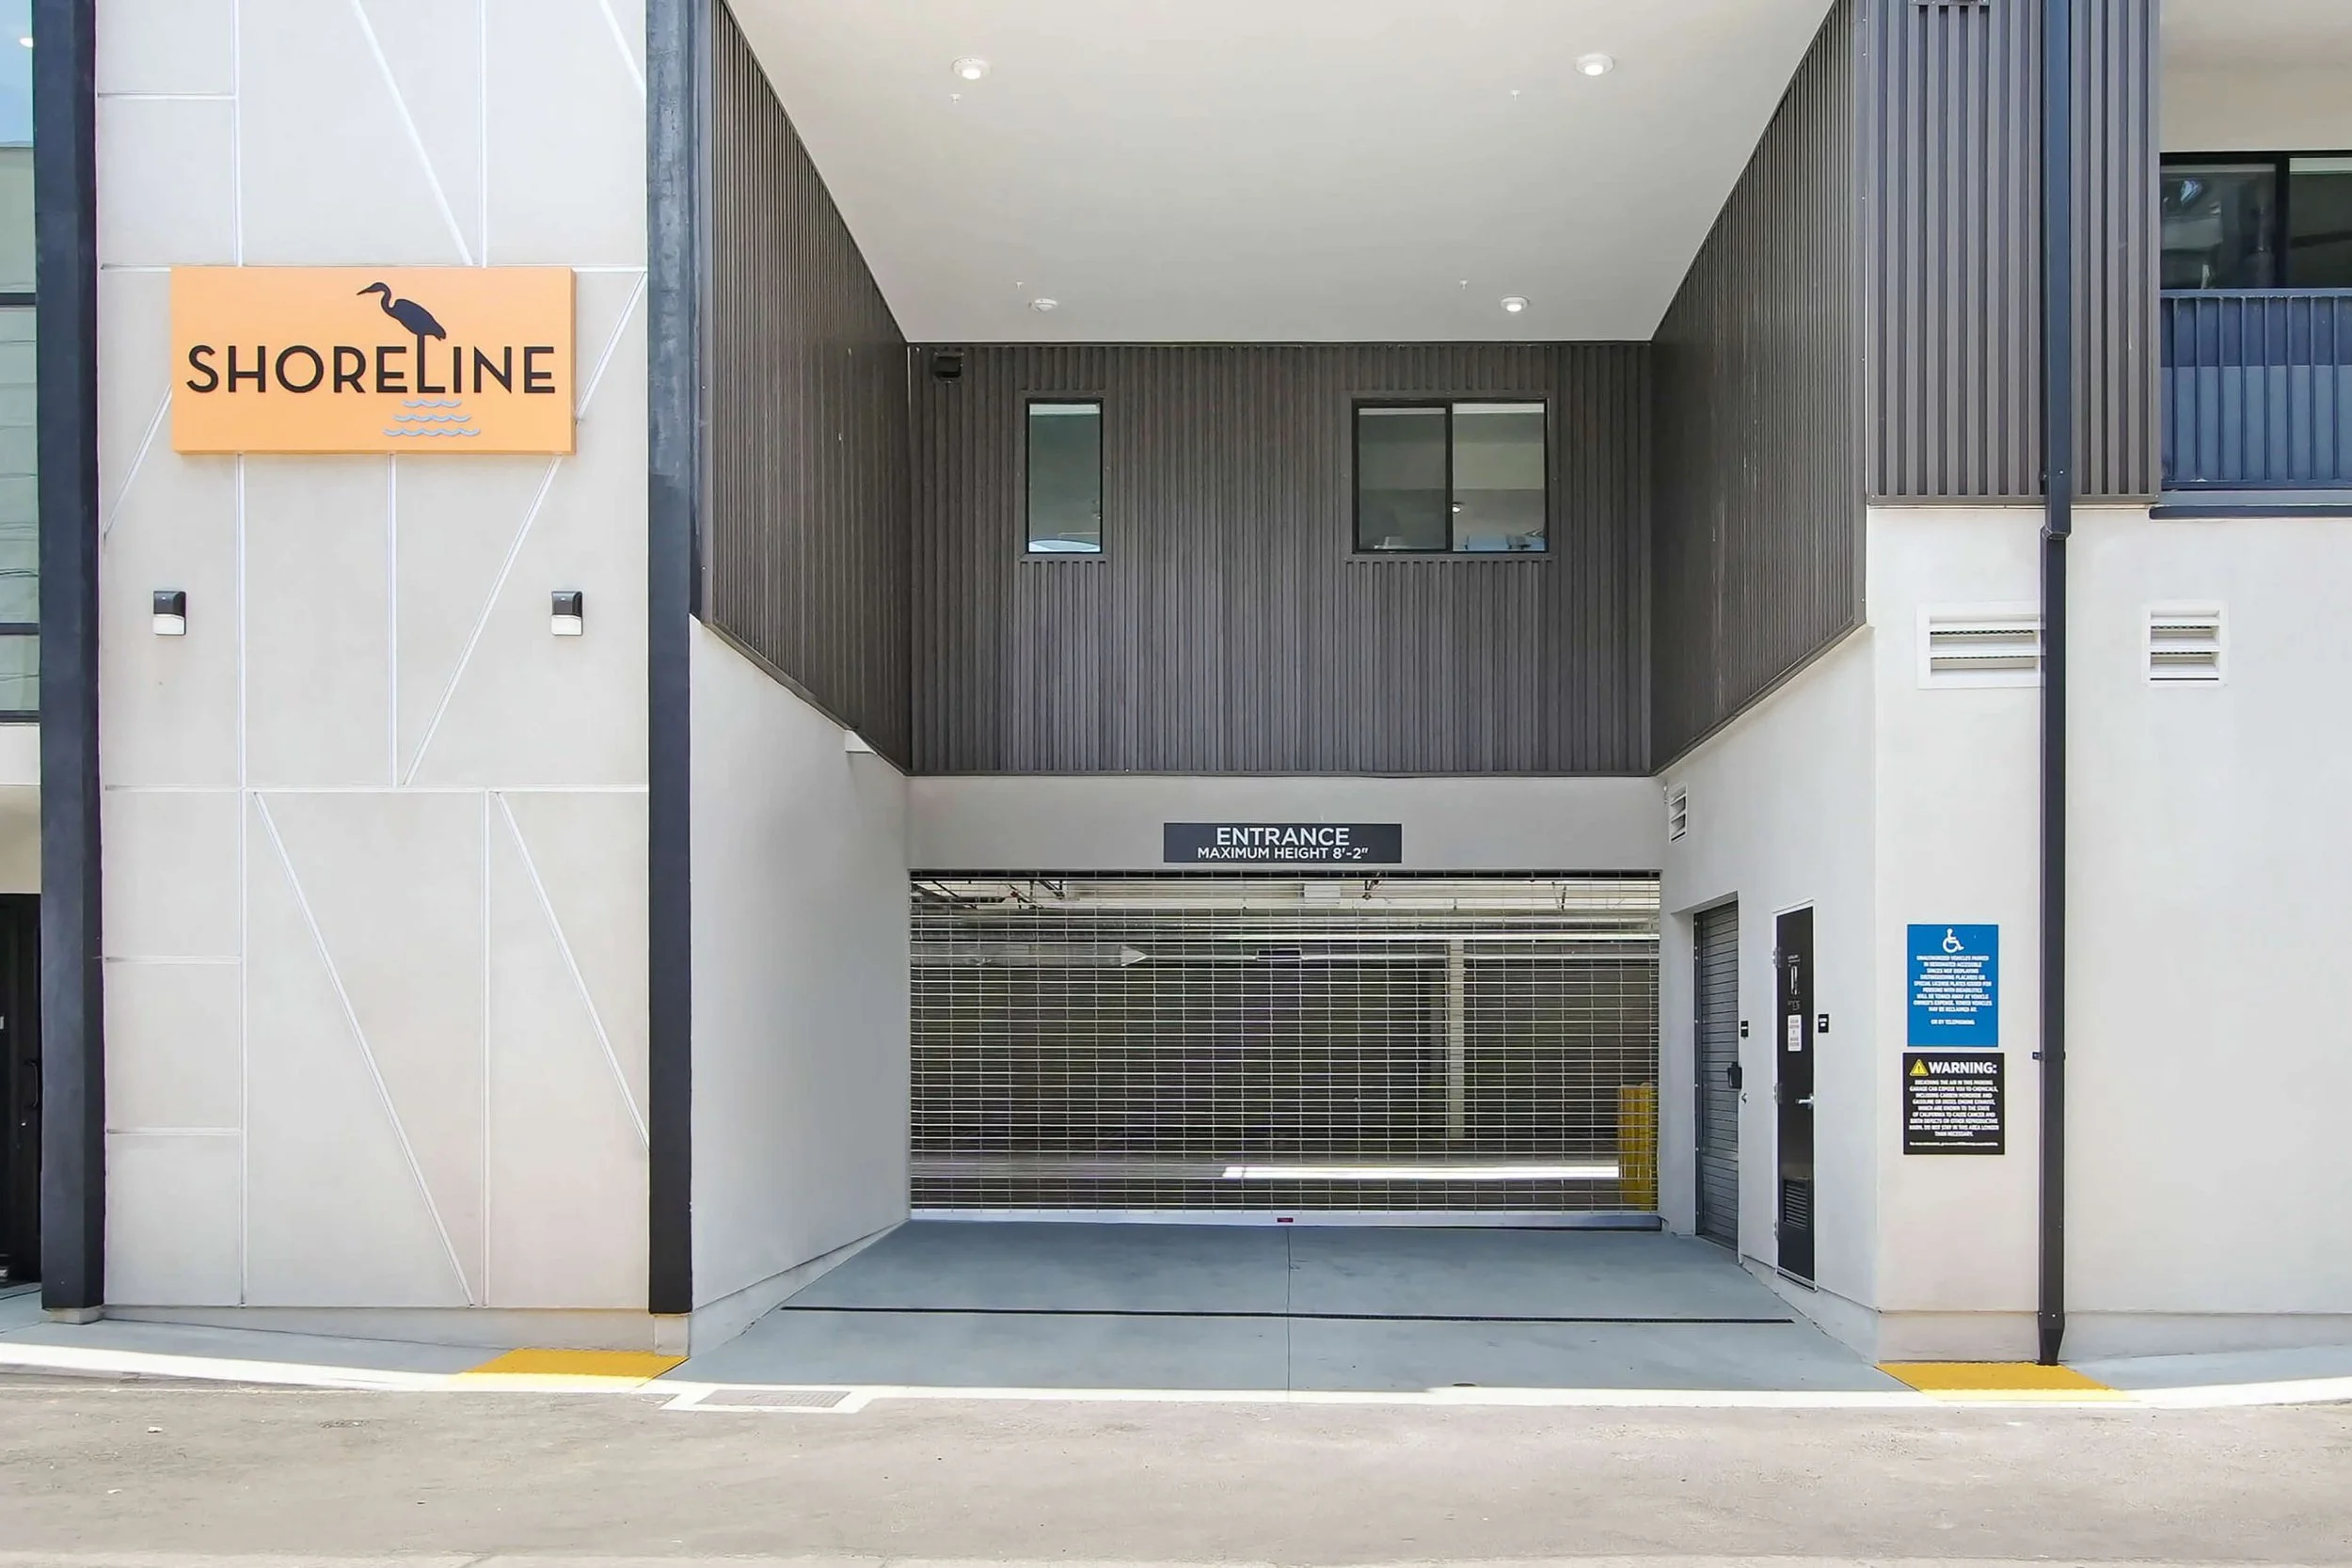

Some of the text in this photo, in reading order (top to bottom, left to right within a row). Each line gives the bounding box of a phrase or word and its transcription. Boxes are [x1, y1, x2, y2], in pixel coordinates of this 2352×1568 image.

[186, 337, 555, 394] SHORELINE
[1216, 827, 1350, 846] ENTRANCE
[1197, 847, 1270, 860] MAXIMUM
[1274, 847, 1328, 860] HEIGHT
[1928, 1061, 1997, 1074] WARNING:
